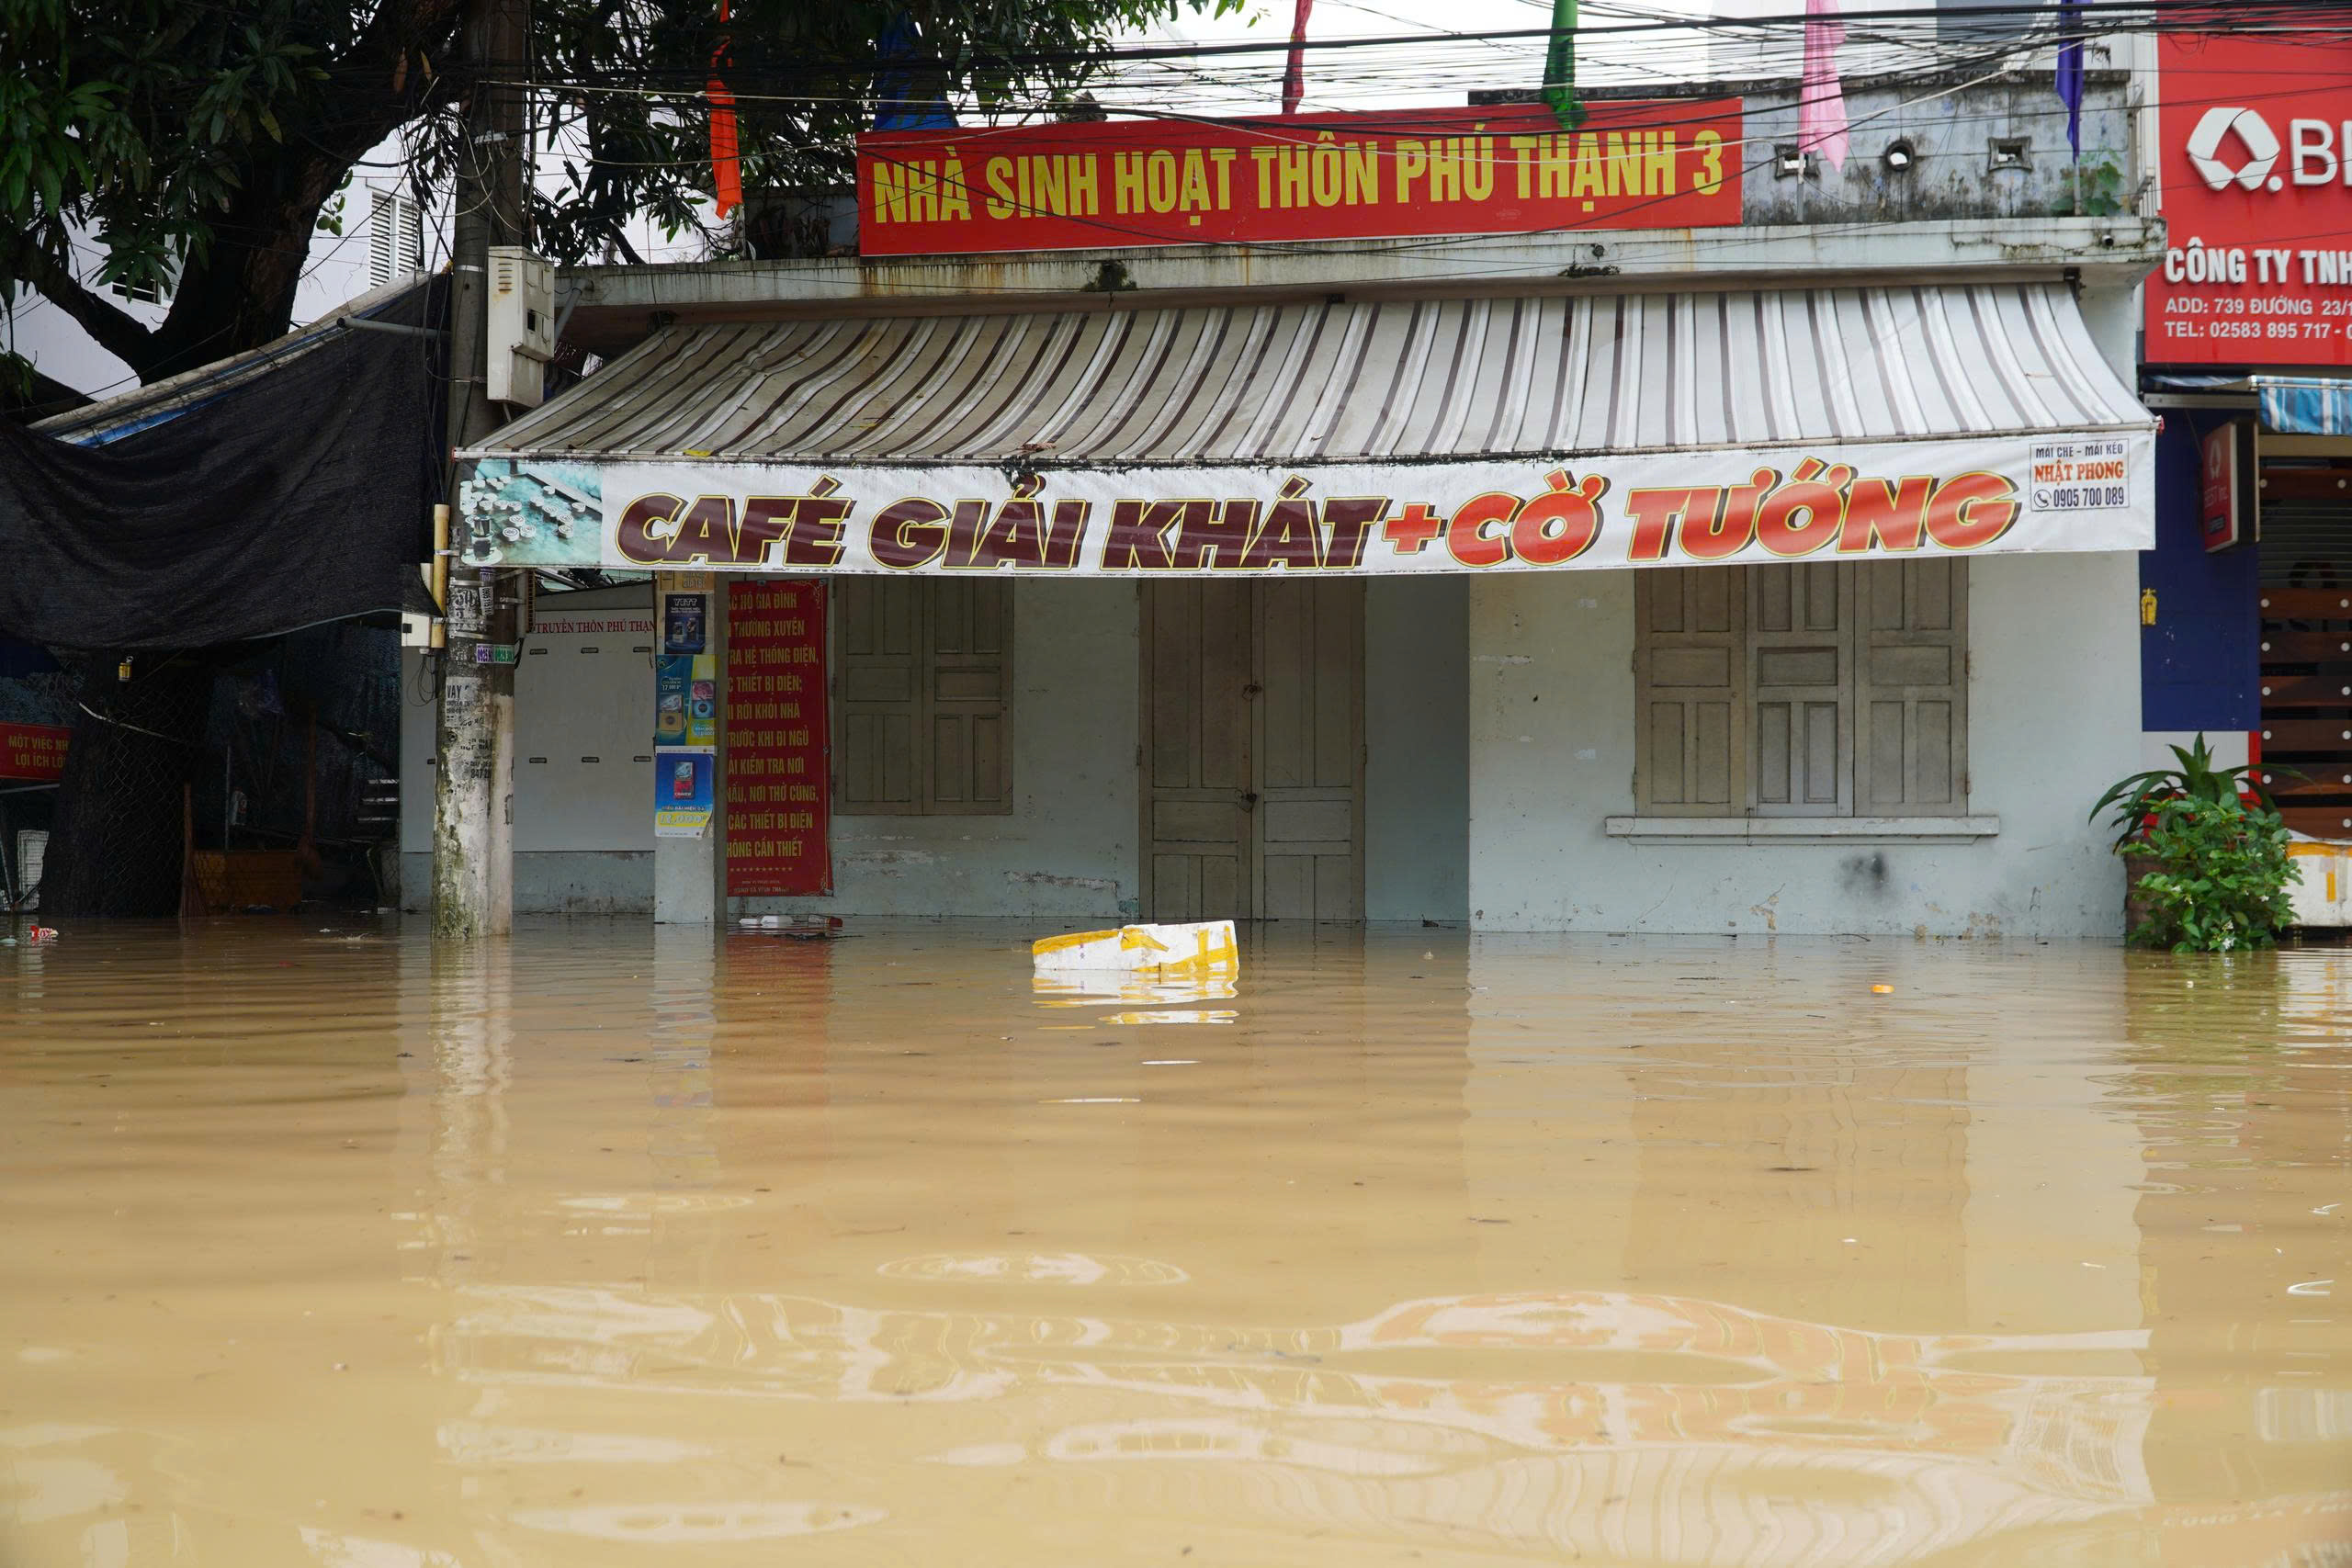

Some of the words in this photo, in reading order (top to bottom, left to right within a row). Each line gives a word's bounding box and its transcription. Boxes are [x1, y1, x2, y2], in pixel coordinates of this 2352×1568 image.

[873, 146, 971, 223] NHÀ
[986, 152, 1100, 220] SINH
[1114, 148, 1237, 226] HOẠT
[1250, 131, 1378, 209] THÔN
[1396, 123, 1494, 203] PHÚ
[1510, 130, 1676, 212] THẠNH
[1692, 130, 1723, 195] 3
[2165, 236, 2247, 284] CÔNG
[2252, 249, 2291, 284] TY
[2165, 298, 2209, 314] ADD:
[2214, 299, 2245, 315] 739
[2250, 295, 2312, 315] ĐƯỜNG
[2165, 321, 2205, 338] TEL:
[2210, 322, 2261, 339] 02583
[2267, 322, 2298, 339] 895
[2302, 323, 2331, 339] 717
[2035, 446, 2054, 458] MÁI
[2056, 446, 2074, 457] CHE
[2085, 443, 2103, 457] MÁI
[2106, 441, 2123, 455] KÉO
[2034, 459, 2074, 486] NHẬT
[2076, 461, 2124, 481] PHONG
[2053, 488, 2080, 507] 0905
[2082, 487, 2102, 507] 700
[2105, 487, 2124, 505] 089
[615, 474, 857, 566] CAFÉ
[867, 474, 1092, 570] GIẢI
[1623, 456, 2021, 561] TƯỚNG
[756, 593, 772, 609] GIA
[774, 589, 797, 609] ĐÌNH
[577, 620, 604, 633] THÔN
[607, 618, 626, 633] PHÚ
[774, 617, 805, 636] XUYÊN
[761, 642, 791, 664] THỐNG
[780, 699, 801, 718] NHÀ
[758, 731, 774, 747] KHI
[776, 731, 786, 747] ĐI
[767, 758, 786, 774] TRA
[787, 757, 805, 773] NƠI
[750, 785, 765, 802] NƠI
[729, 811, 747, 830] CÁC
[750, 808, 775, 829] THIẾT
[790, 809, 813, 832] ĐIỆN
[776, 835, 802, 857] THIẾT
